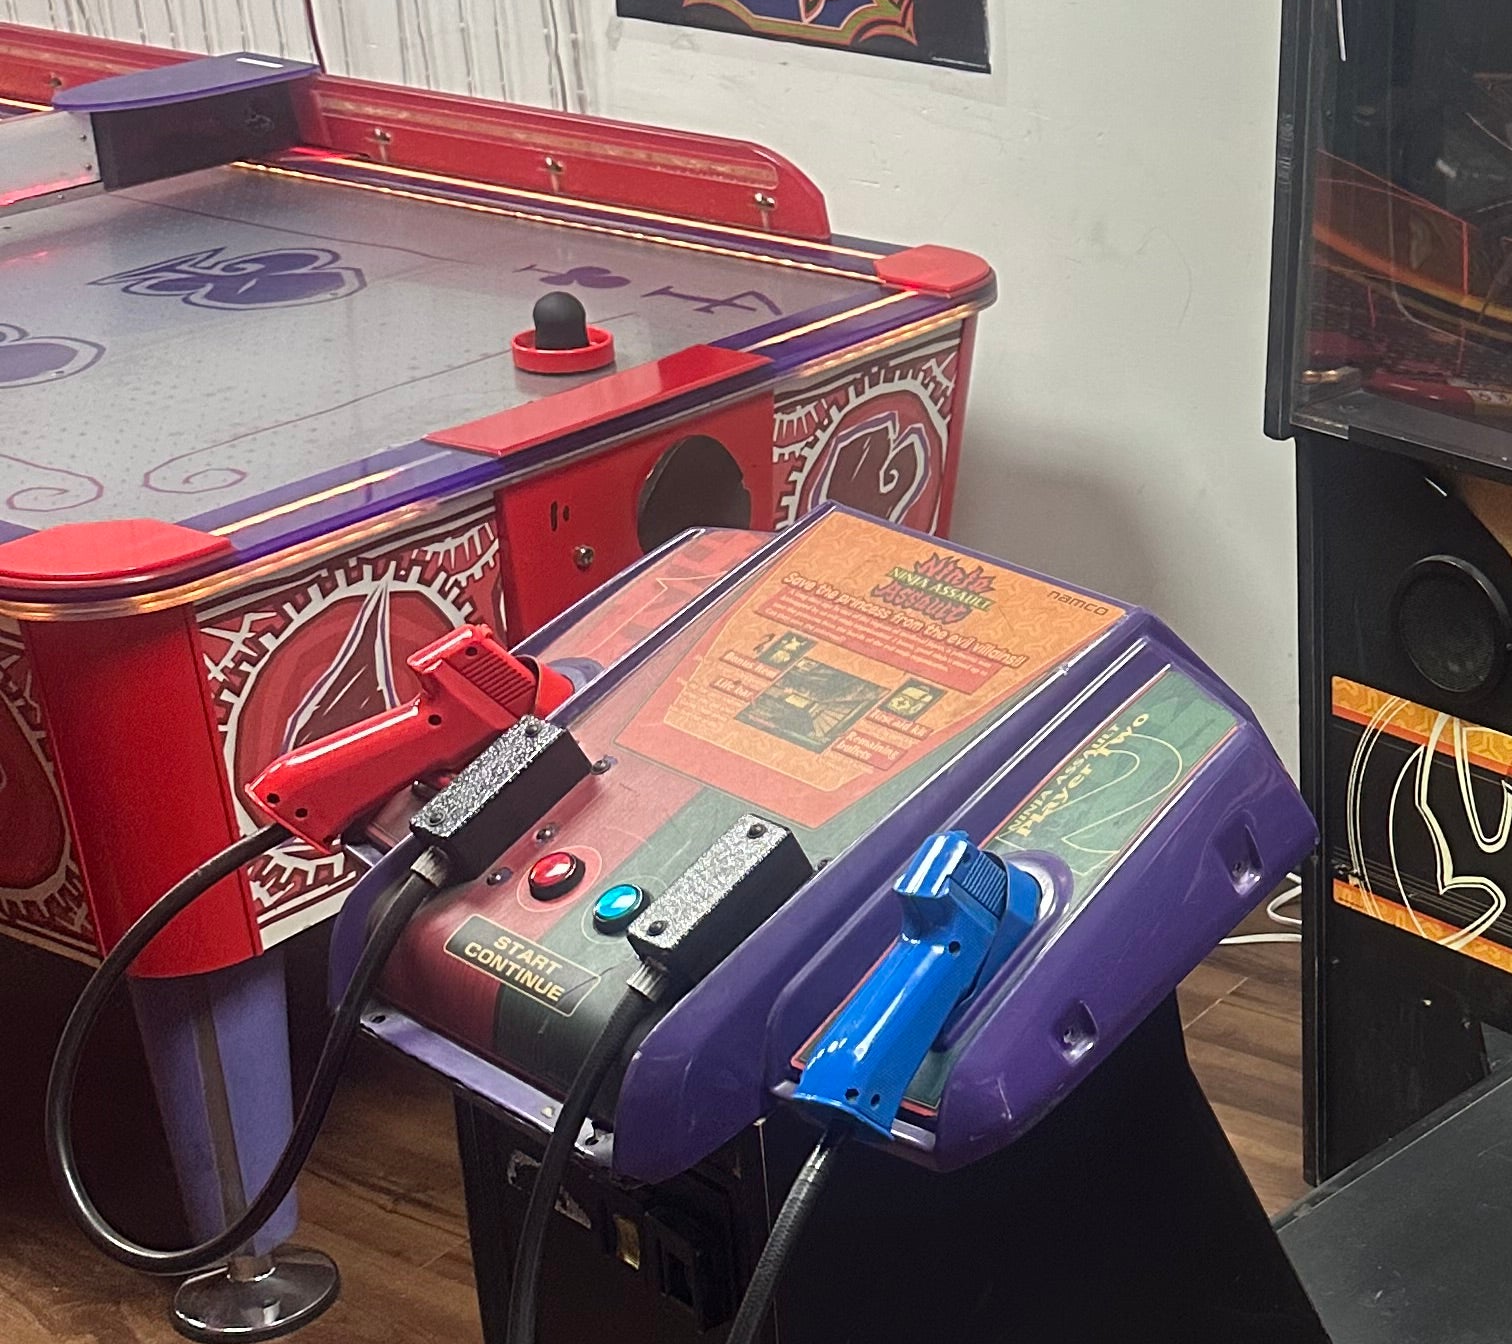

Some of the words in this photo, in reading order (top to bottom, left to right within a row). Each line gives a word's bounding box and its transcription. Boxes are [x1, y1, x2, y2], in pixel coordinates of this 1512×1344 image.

[891, 567, 931, 592] NINJA
[929, 581, 993, 610] ASSAULT
[1048, 590, 1109, 616] namco
[785, 570, 816, 592] Save
[816, 582, 839, 601] the
[836, 591, 891, 621] princess
[891, 610, 923, 633] from
[924, 622, 947, 642] the
[946, 629, 974, 652] evil
[1008, 789, 1053, 832] NINJA
[464, 942, 566, 1002] CONTINUE
[494, 935, 563, 975] START
